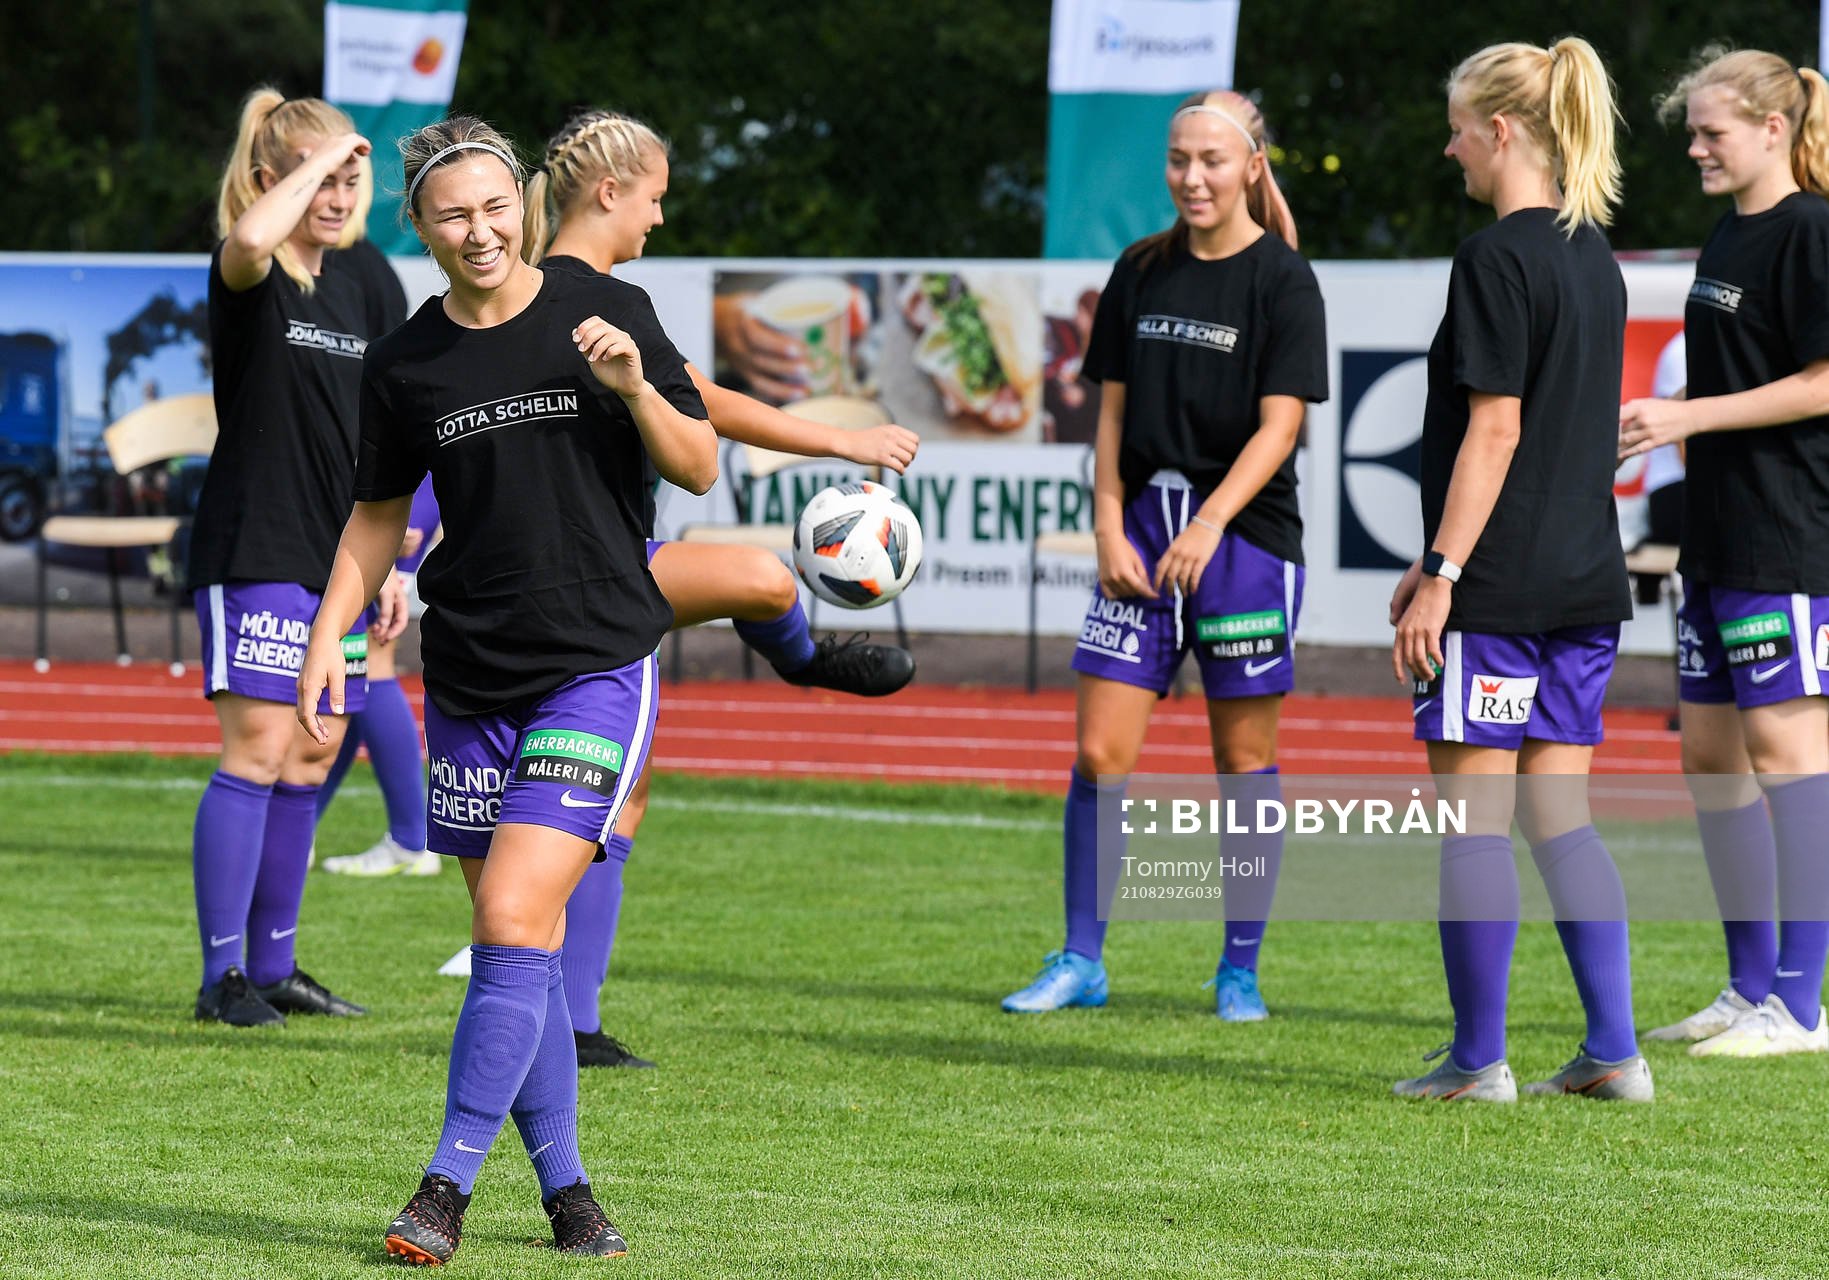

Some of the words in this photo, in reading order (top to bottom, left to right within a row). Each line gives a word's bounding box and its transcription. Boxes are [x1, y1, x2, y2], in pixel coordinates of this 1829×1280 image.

[1173, 323, 1237, 348] FSCHER
[436, 410, 490, 440] LOTTA
[495, 395, 577, 421] SCHELIN
[972, 478, 1097, 541] ENER
[1256, 638, 1274, 654] AB
[1757, 642, 1777, 659] AB
[525, 736, 619, 765] ENERBACKENS
[526, 758, 579, 781] MÅLERI
[582, 768, 603, 787] AB
